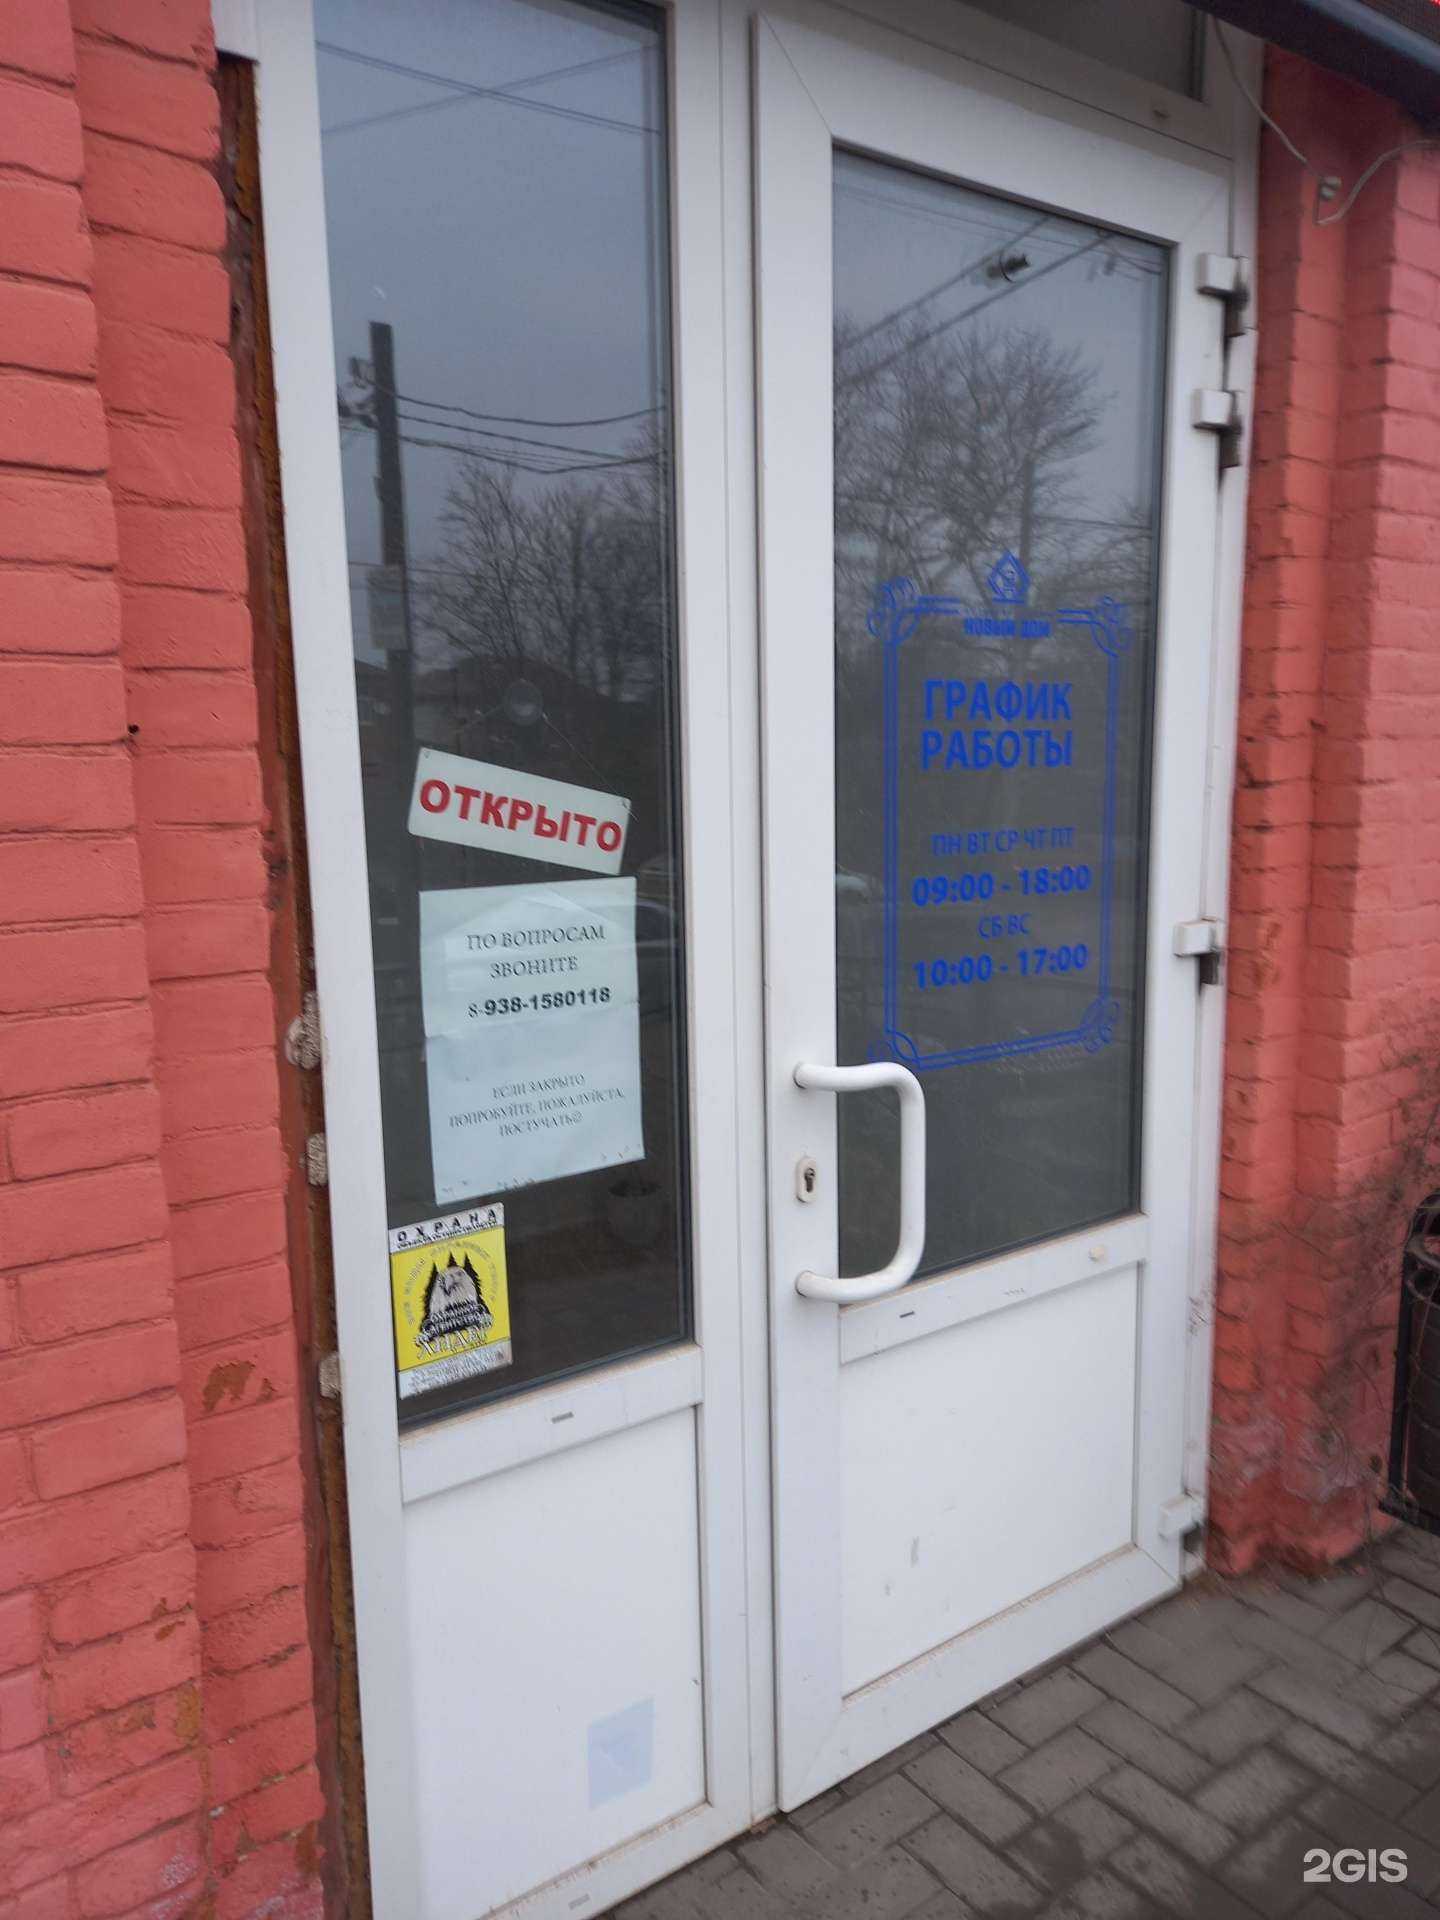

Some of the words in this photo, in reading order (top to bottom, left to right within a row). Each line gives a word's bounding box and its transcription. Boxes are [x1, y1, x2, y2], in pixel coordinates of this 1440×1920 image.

[923, 678, 1073, 722] ГРАФИК
[921, 728, 1073, 772] РАБОТЫ
[419, 779, 622, 852] ОТКРЫТО
[931, 832, 961, 855] ПН
[967, 831, 990, 854] ВТ
[995, 829, 1019, 852] СР
[1024, 827, 1045, 849] ЧТ
[1051, 825, 1075, 848] ПТ
[912, 872, 994, 907] 09:00
[1018, 865, 1091, 895] 18:00
[466, 934, 497, 951] ПО
[502, 924, 607, 948] ВОПРОСАМ
[977, 914, 1001, 939] СБ
[1007, 913, 1032, 936] ВС
[489, 955, 580, 979] ЗВОНИТЕ
[913, 953, 993, 990] 10:00
[1017, 943, 1089, 976] 17:00
[468, 987, 612, 1019] 8-938-1580118
